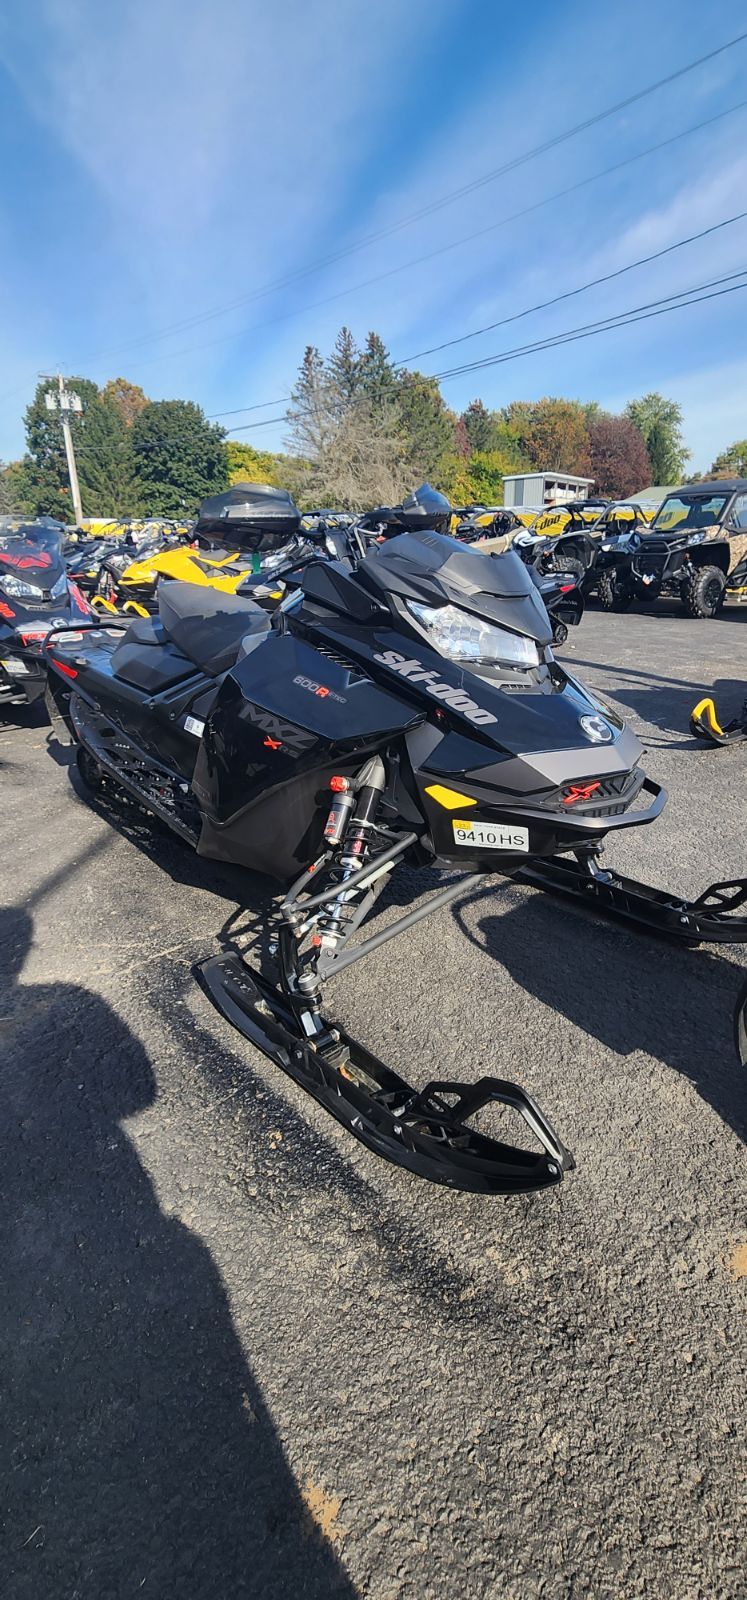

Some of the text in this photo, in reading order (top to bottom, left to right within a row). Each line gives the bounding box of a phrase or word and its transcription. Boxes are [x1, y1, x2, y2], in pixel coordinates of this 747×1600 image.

[293, 675, 330, 698] 600R
[373, 650, 498, 725] ski-doo
[238, 703, 319, 750] MXZ
[456, 829, 497, 844] 9410
[500, 834, 525, 846] HS
